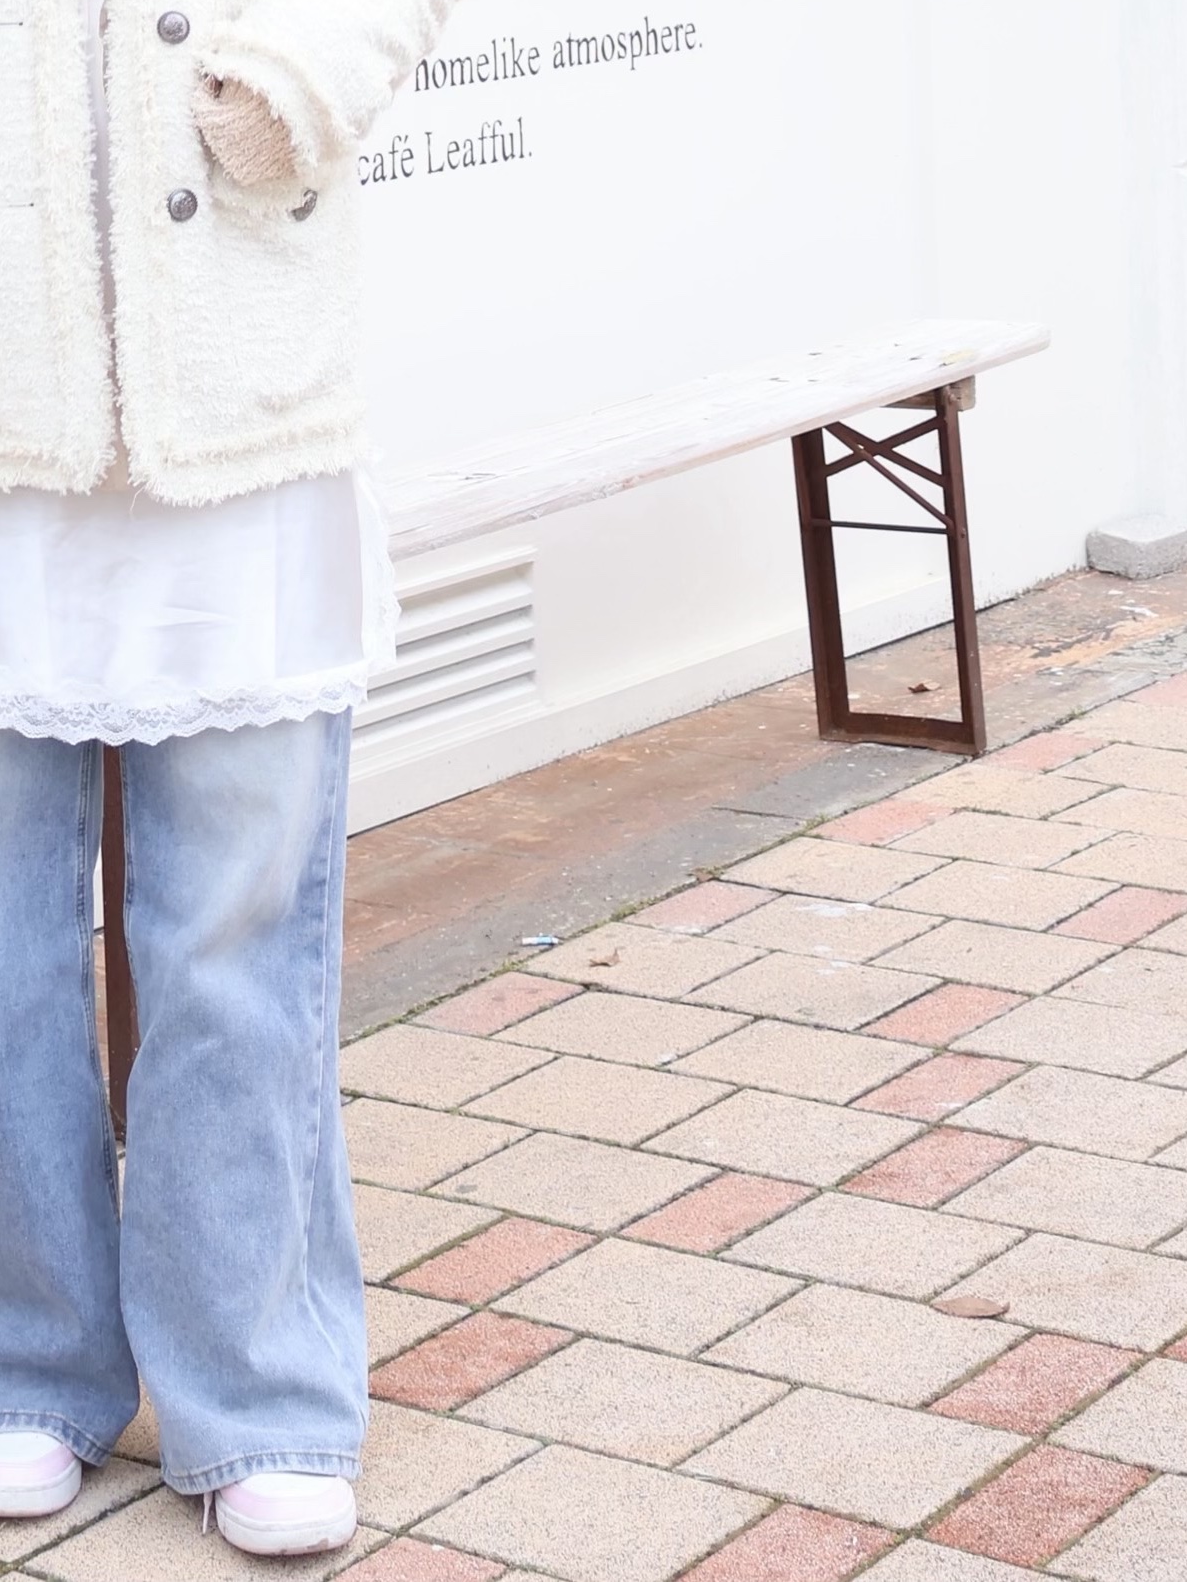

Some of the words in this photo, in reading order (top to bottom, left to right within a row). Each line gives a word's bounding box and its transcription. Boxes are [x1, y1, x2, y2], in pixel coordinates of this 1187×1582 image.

[552, 16, 703, 71] atmosphere.
[357, 134, 414, 186] café
[424, 117, 533, 174] Leafful.
